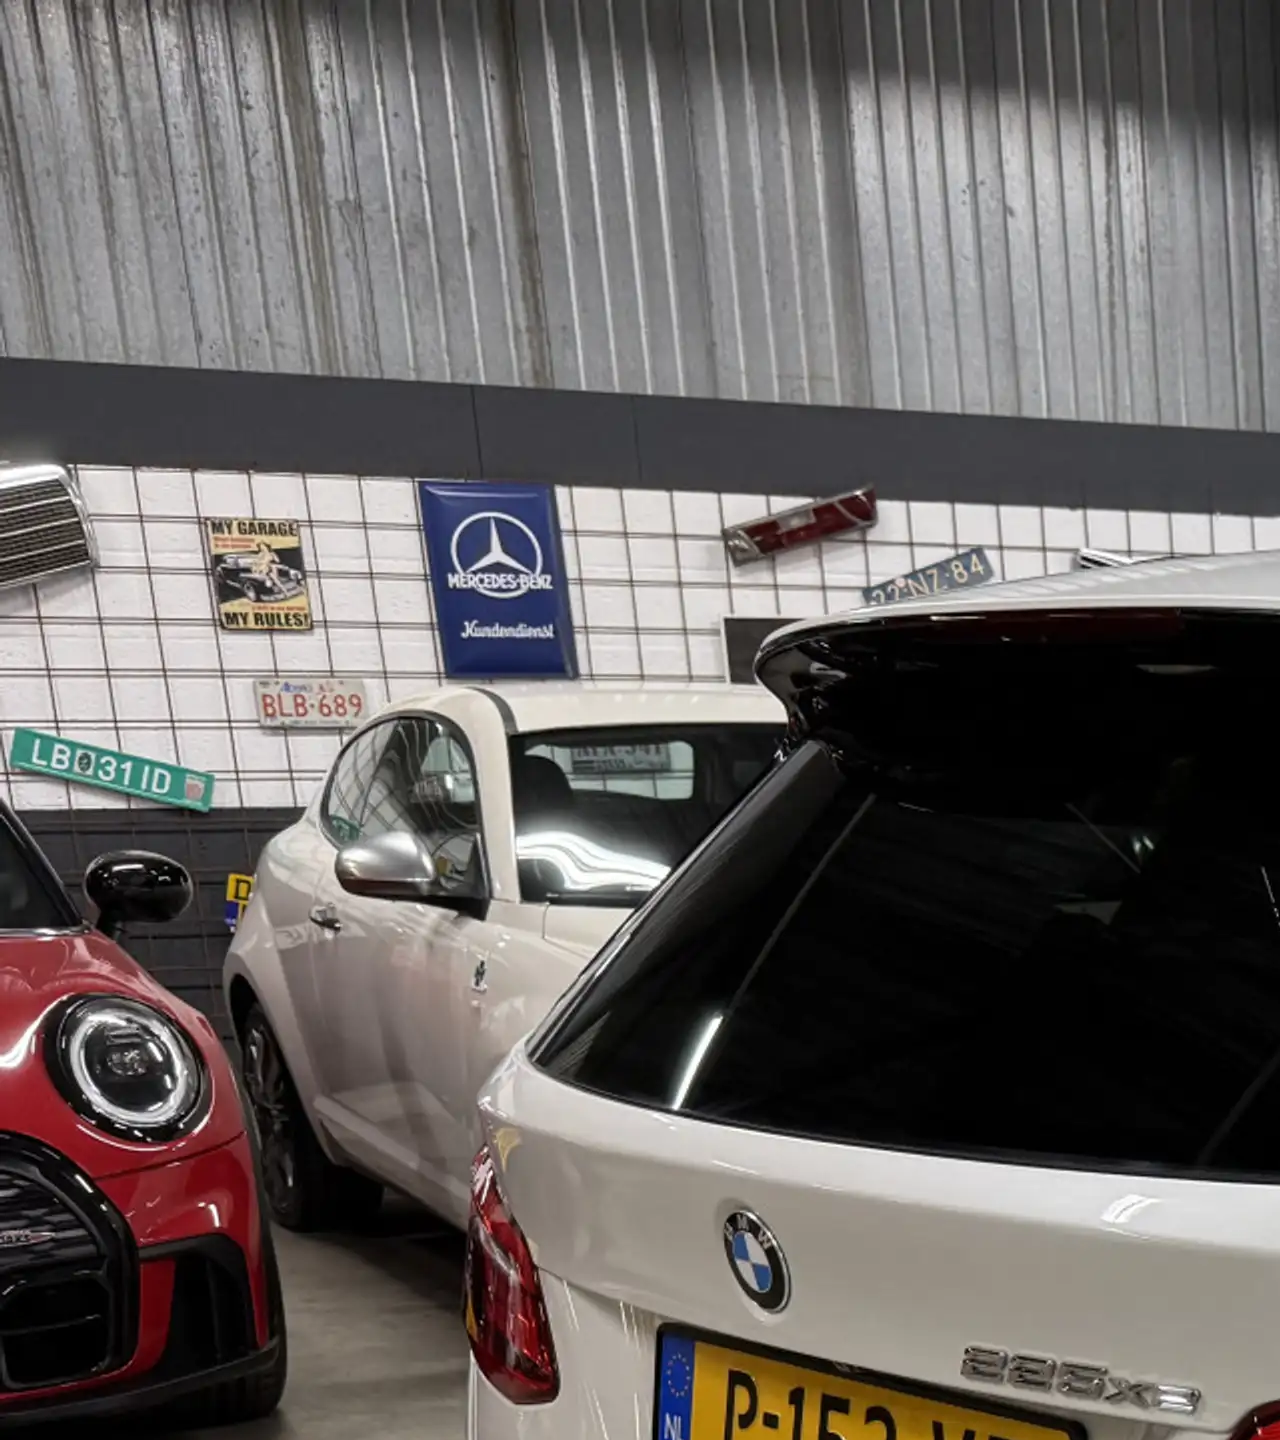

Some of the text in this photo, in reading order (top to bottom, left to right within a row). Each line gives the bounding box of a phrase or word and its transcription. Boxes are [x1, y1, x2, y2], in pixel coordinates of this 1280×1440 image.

[210, 519, 298, 537] MY GARAGE
[447, 573, 554, 590] MERCEDES-BENZ
[224, 611, 308, 627] MY RULES!
[460, 620, 554, 639] Kundendienst
